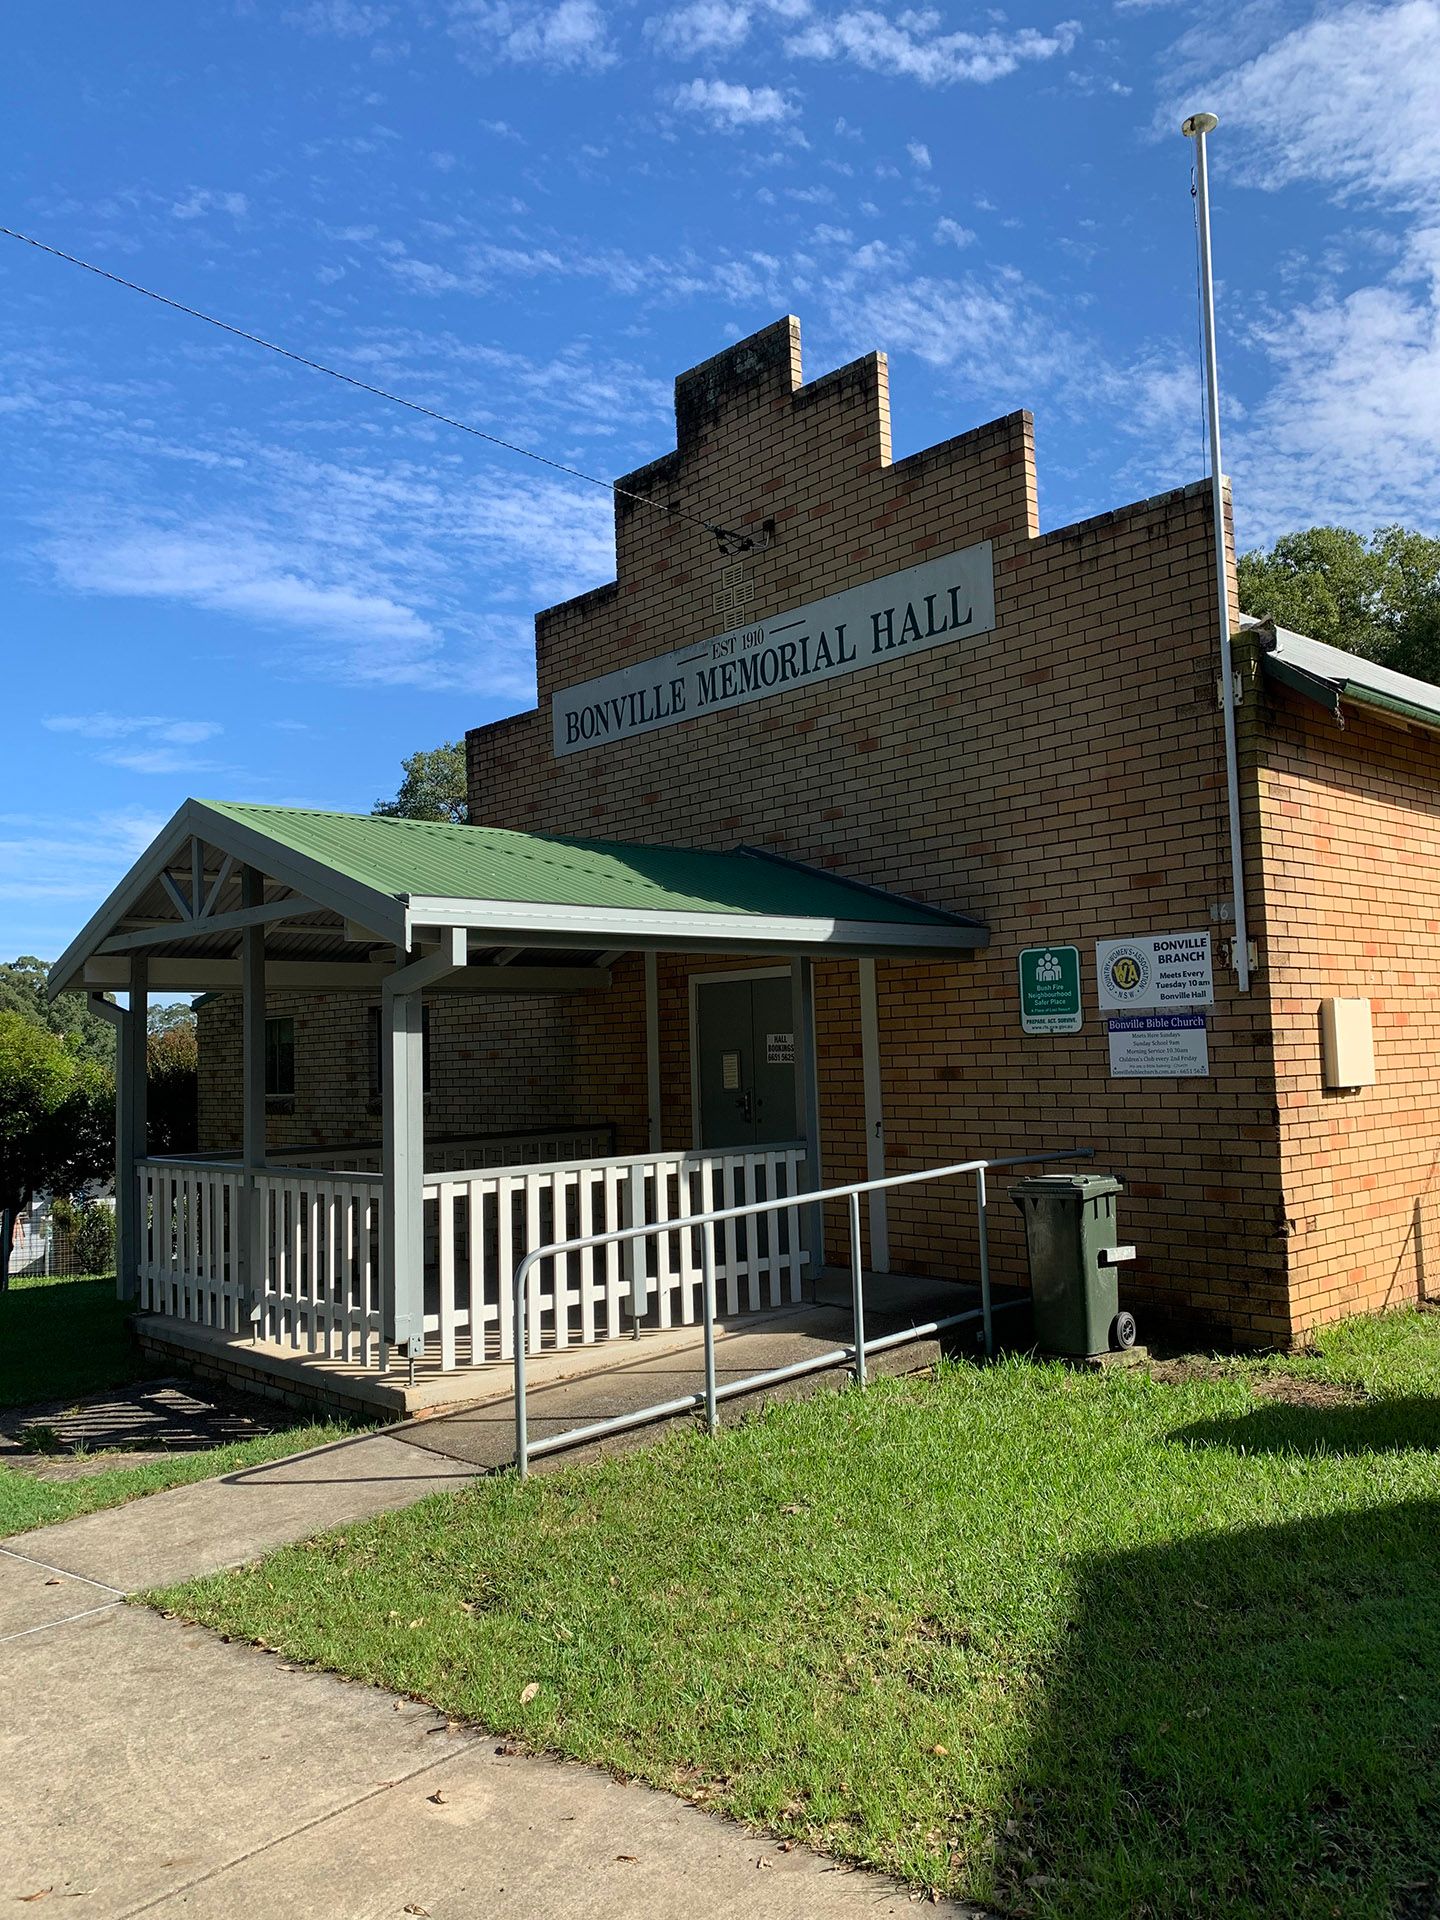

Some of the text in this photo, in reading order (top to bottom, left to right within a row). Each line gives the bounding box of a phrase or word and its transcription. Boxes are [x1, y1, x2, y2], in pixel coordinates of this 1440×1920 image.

[712, 628, 764, 660] EST 1910
[564, 585, 973, 745] BONVILLE MEMORIAL HALL
[1153, 937, 1208, 952] BONVILLE
[1158, 951, 1205, 964] BRANCH
[1134, 951, 1149, 989] ASSOCIATION
[1160, 970, 1205, 980] Meets Every
[1103, 963, 1115, 991] COUNTRY
[1052, 983, 1064, 991] Fire
[1155, 981, 1187, 989] Tuesday
[1189, 979, 1198, 987] 10
[1027, 991, 1072, 1000] Neighbourhood
[1160, 990, 1207, 1000] Bonville Hall
[1109, 1016, 1205, 1030] Bonville Bible Church
[773, 1035, 788, 1043] HALL
